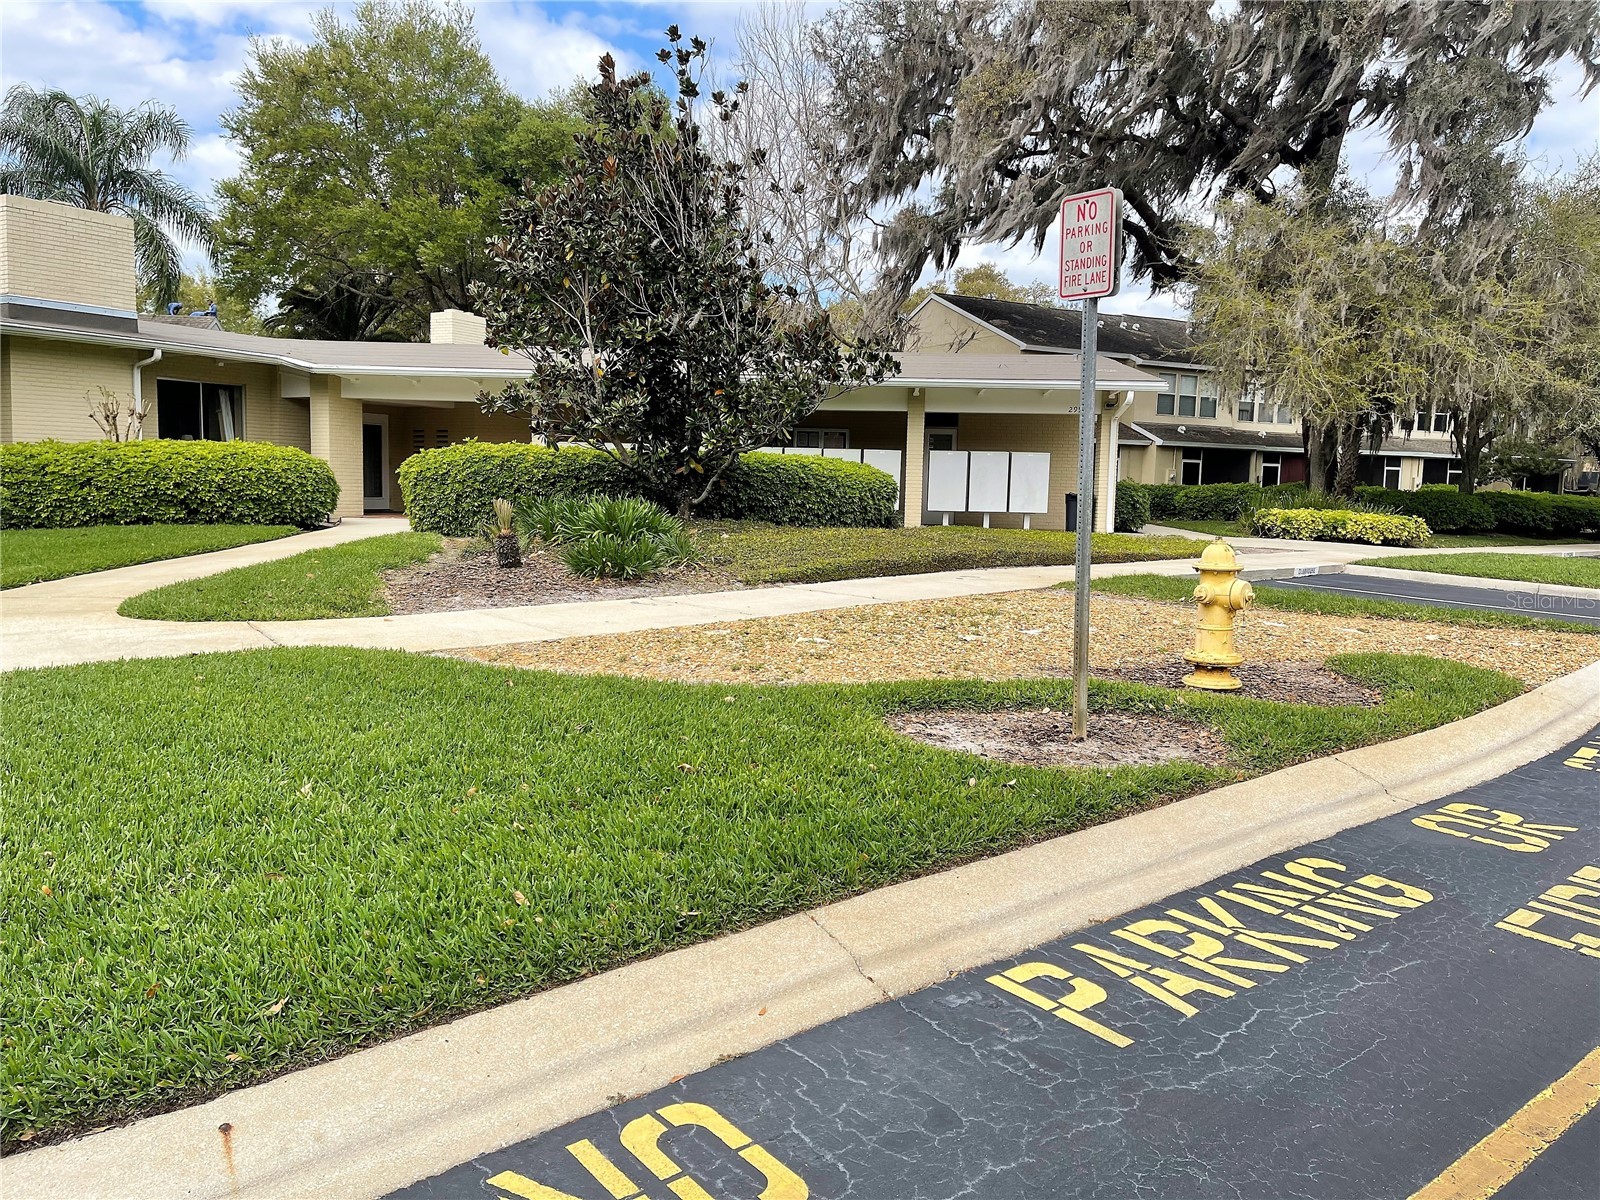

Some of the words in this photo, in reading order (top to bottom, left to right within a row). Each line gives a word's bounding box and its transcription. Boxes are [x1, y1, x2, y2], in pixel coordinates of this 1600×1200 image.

[1076, 200, 1098, 223] NO
[1065, 221, 1109, 240] PARKING
[1079, 240, 1093, 254] OR
[1064, 254, 1107, 272] STANDING
[1064, 273, 1082, 288] FIRE
[1084, 270, 1107, 285] LANE
[1411, 802, 1580, 853] OR
[984, 856, 1434, 1048] PARKING
